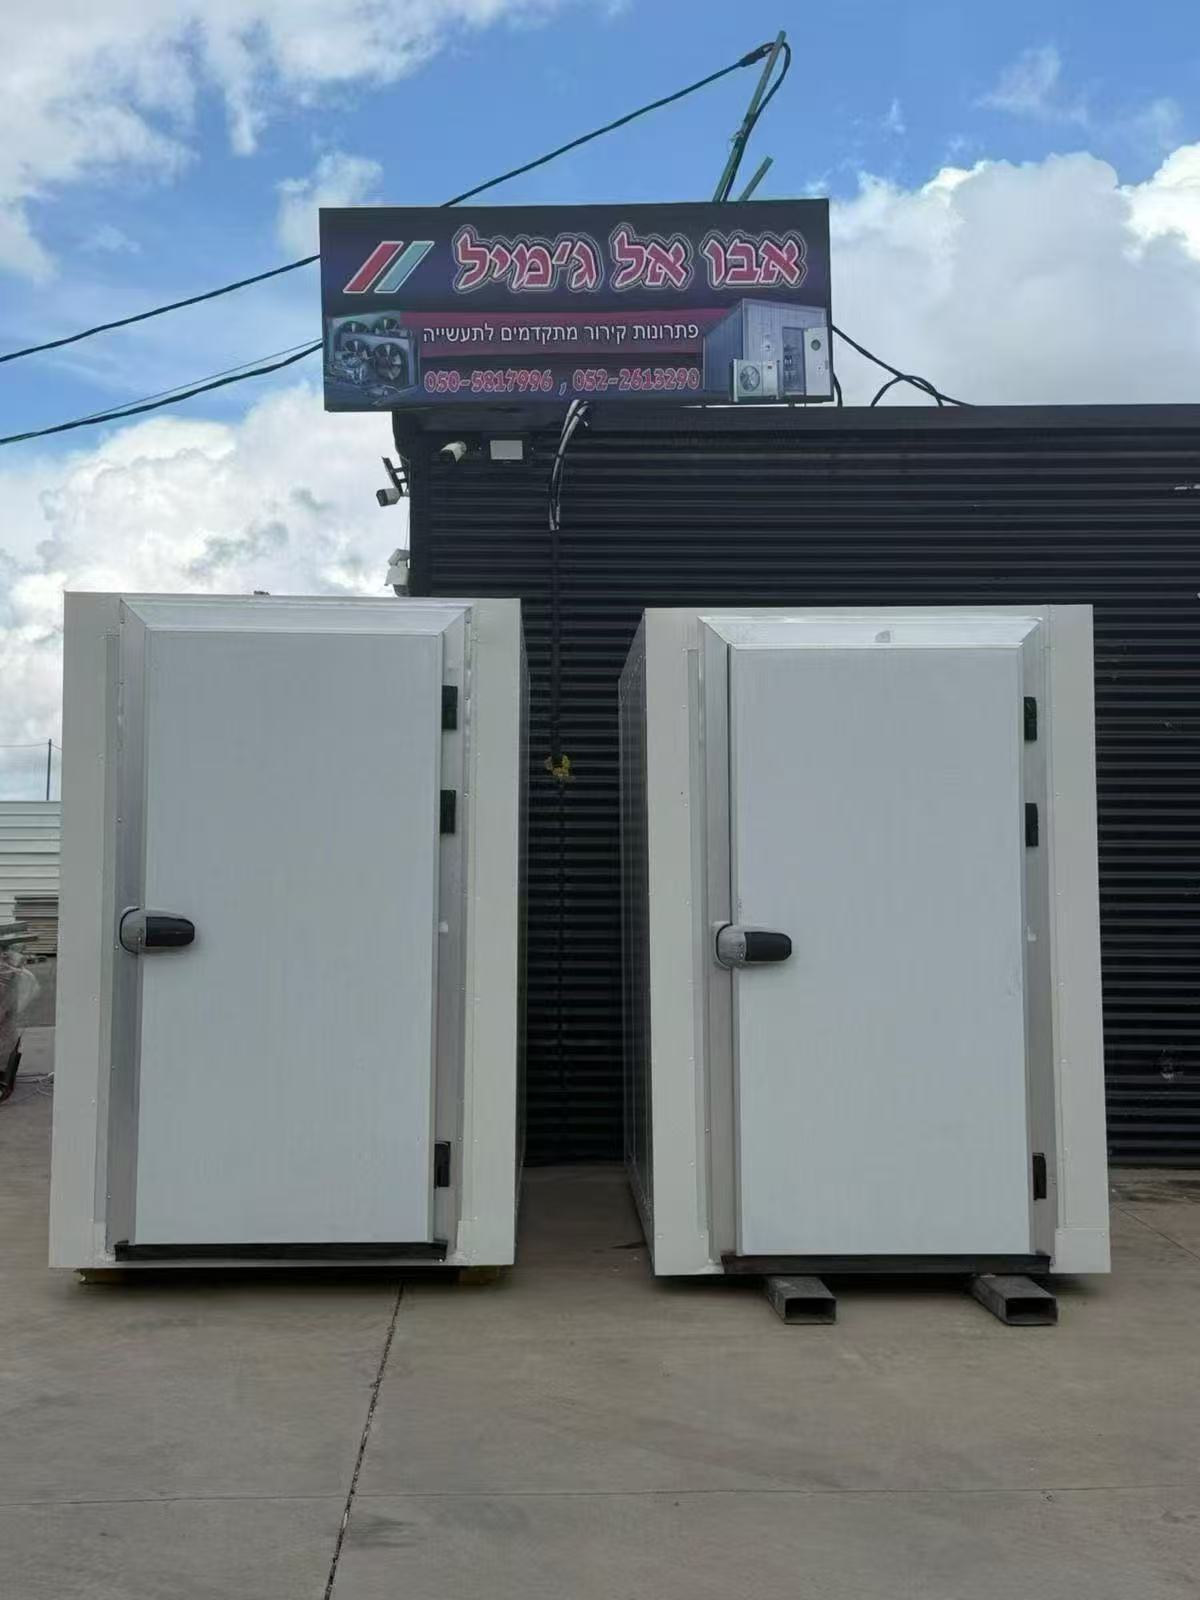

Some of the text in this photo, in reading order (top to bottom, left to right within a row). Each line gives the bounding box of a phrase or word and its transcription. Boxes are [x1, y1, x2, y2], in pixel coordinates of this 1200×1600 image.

[611, 226, 691, 289] אל
[701, 233, 805, 288] אבו
[423, 322, 699, 345] פתרונות קירור מתקדמים לתעשייה
[424, 368, 554, 393] 050-5817996
[572, 367, 700, 391] 052-2613290
